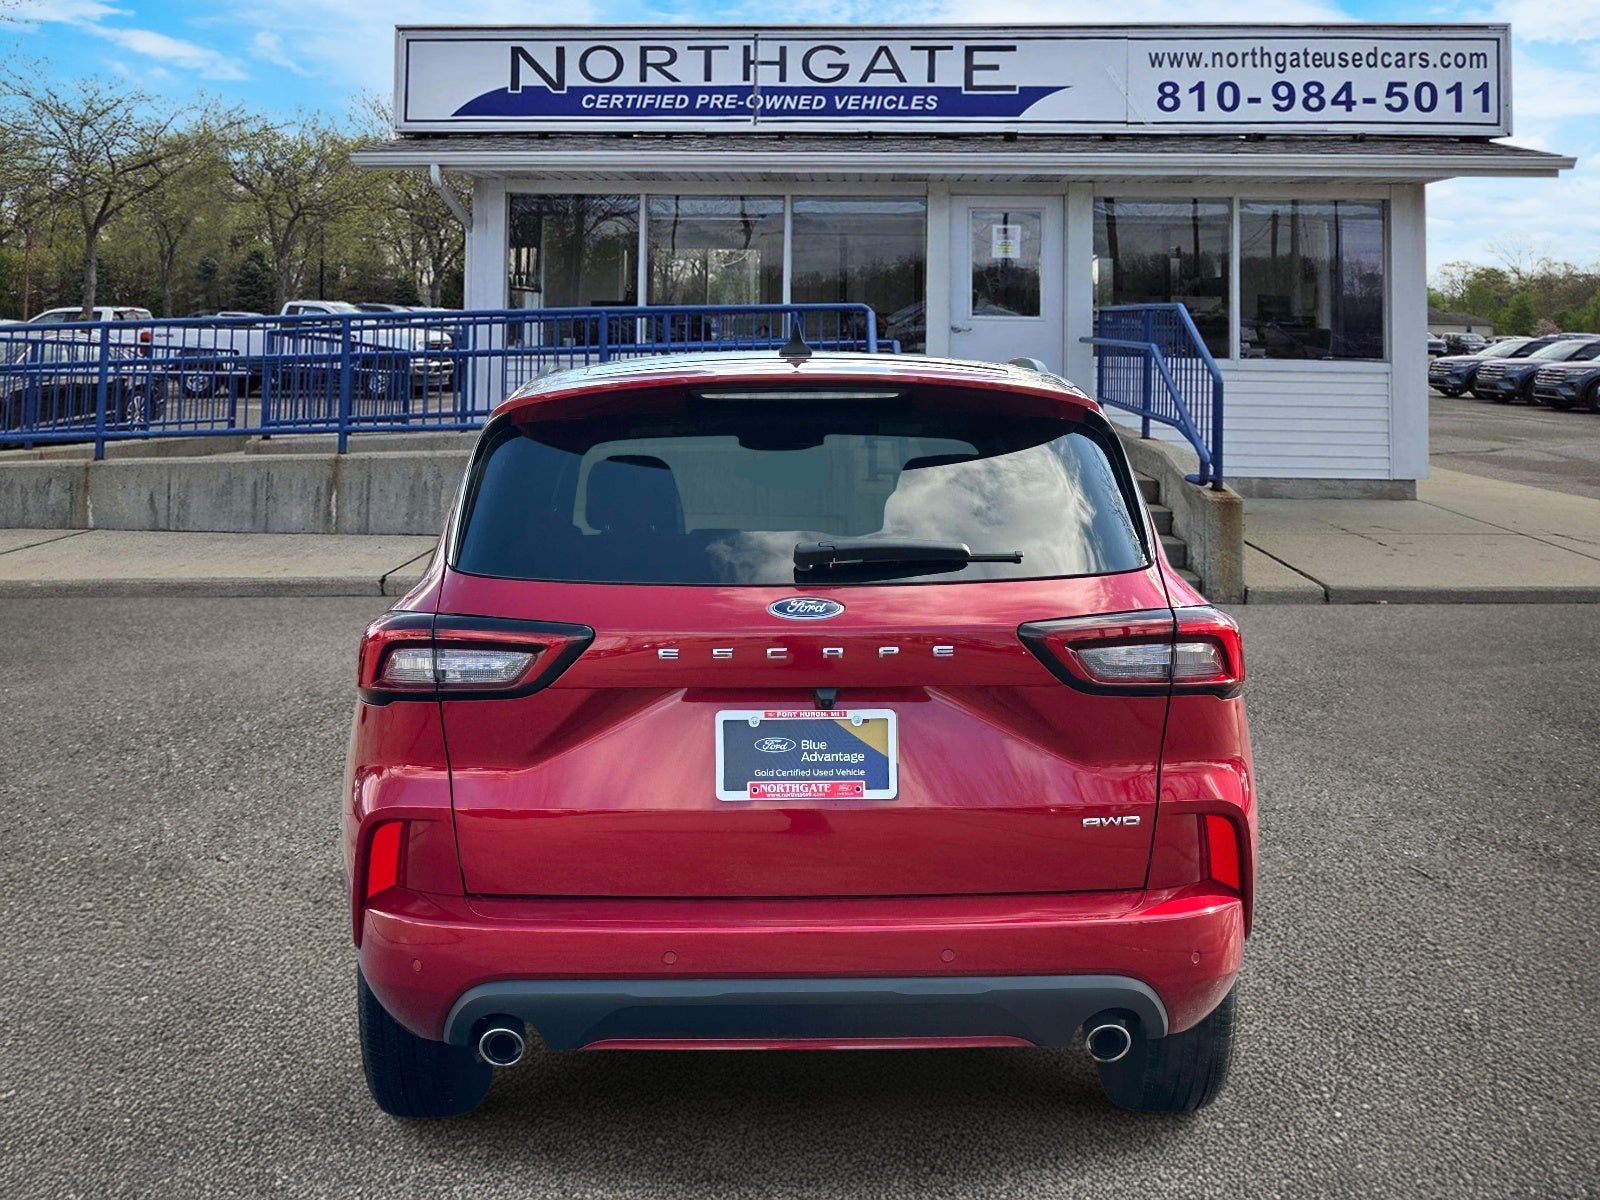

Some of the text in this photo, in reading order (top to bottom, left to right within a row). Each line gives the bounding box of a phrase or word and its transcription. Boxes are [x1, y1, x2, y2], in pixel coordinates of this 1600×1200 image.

[1149, 46, 1488, 73] www.northgateusedcars.com
[510, 44, 1018, 92] NORTHGATE
[581, 93, 938, 111] CERTIFIED PRE-OWNED VEHICLES
[1156, 80, 1491, 114] 810-984-5011
[657, 644, 955, 660] ESCAPE
[801, 739, 827, 750] Blue
[800, 751, 865, 764] Advantage
[754, 768, 866, 777] Gold Certified Used Vehicle
[760, 783, 832, 793] NORTHGATE
[1082, 815, 1141, 828] AWD
